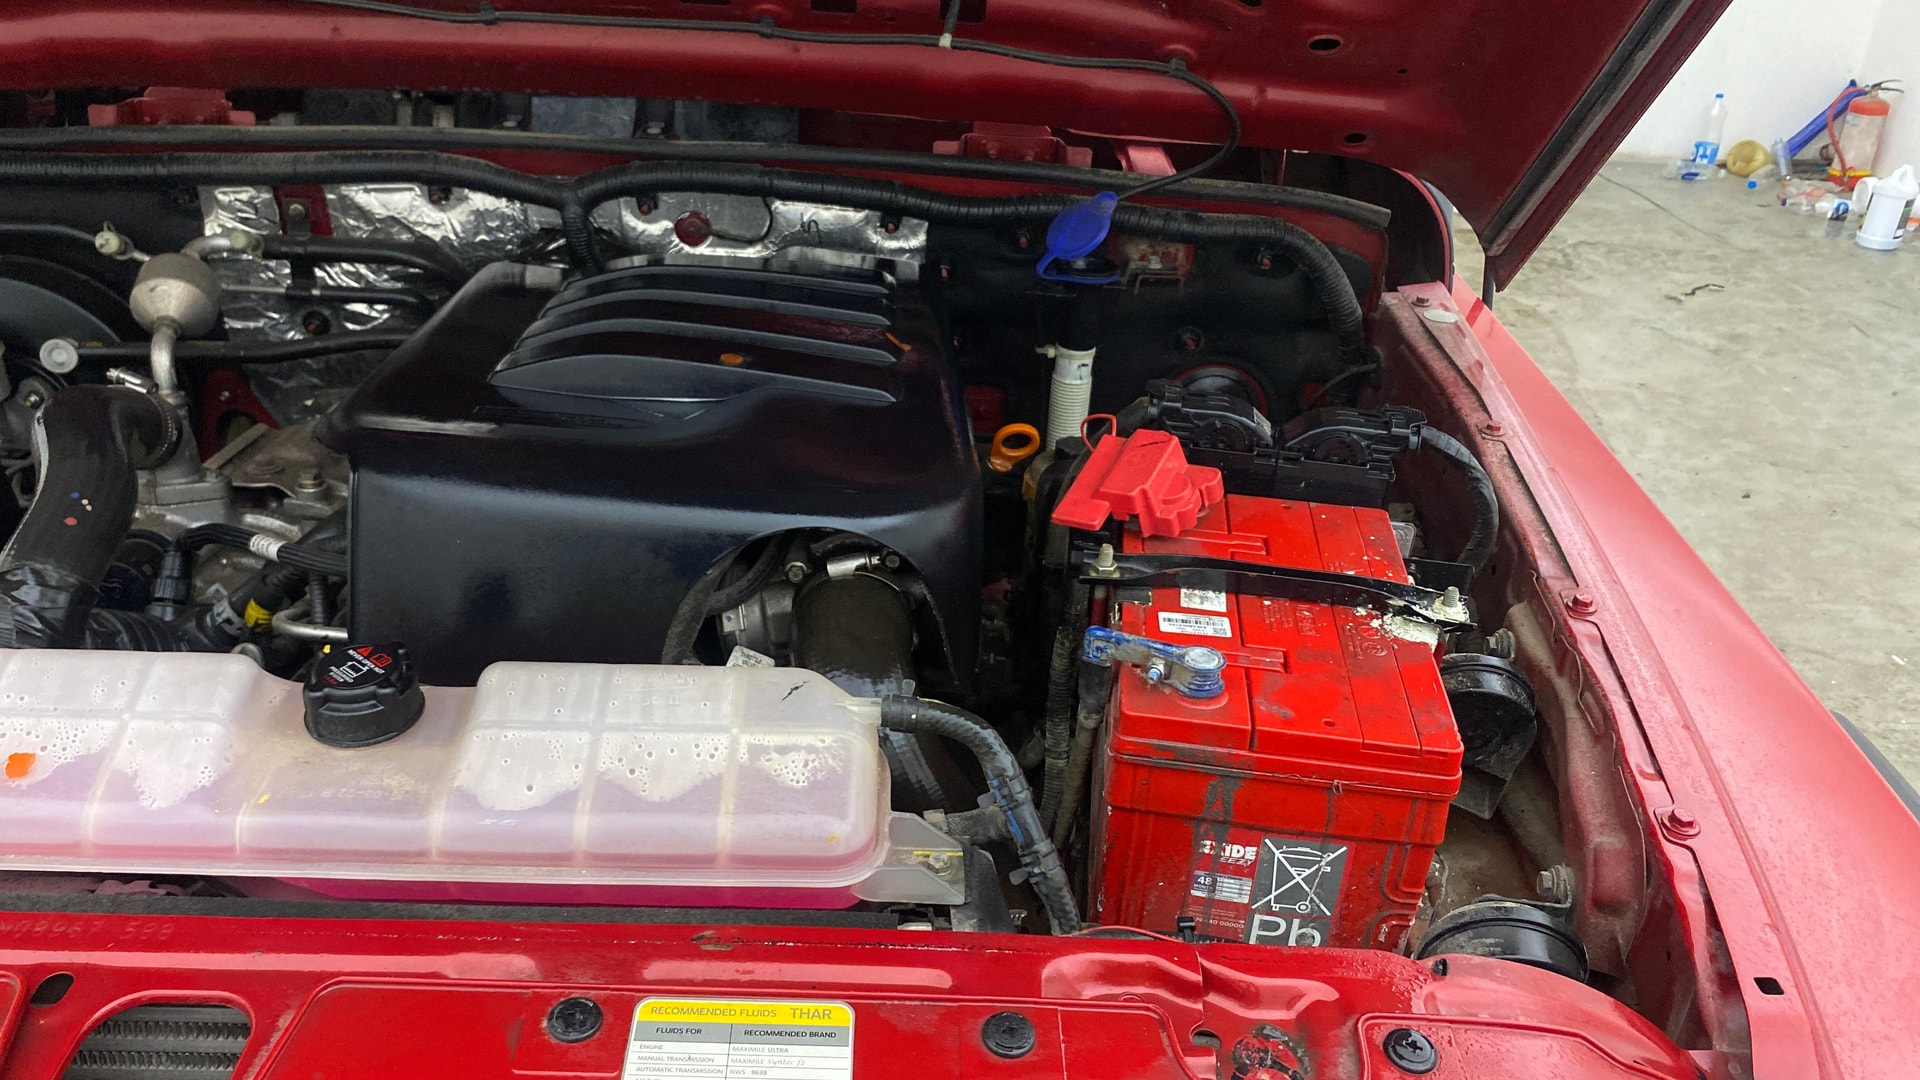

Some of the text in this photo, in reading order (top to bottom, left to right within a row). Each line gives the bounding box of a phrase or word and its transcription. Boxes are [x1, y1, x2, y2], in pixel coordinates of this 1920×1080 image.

[1197, 876, 1213, 885] 48
[1249, 914, 1322, 946] Pb
[651, 1006, 832, 1020] RECOMMENDED FLUIDS THAR
[656, 1026, 684, 1035] FLUIDS
[744, 1030, 837, 1039] RECOMMENDED BRAND
